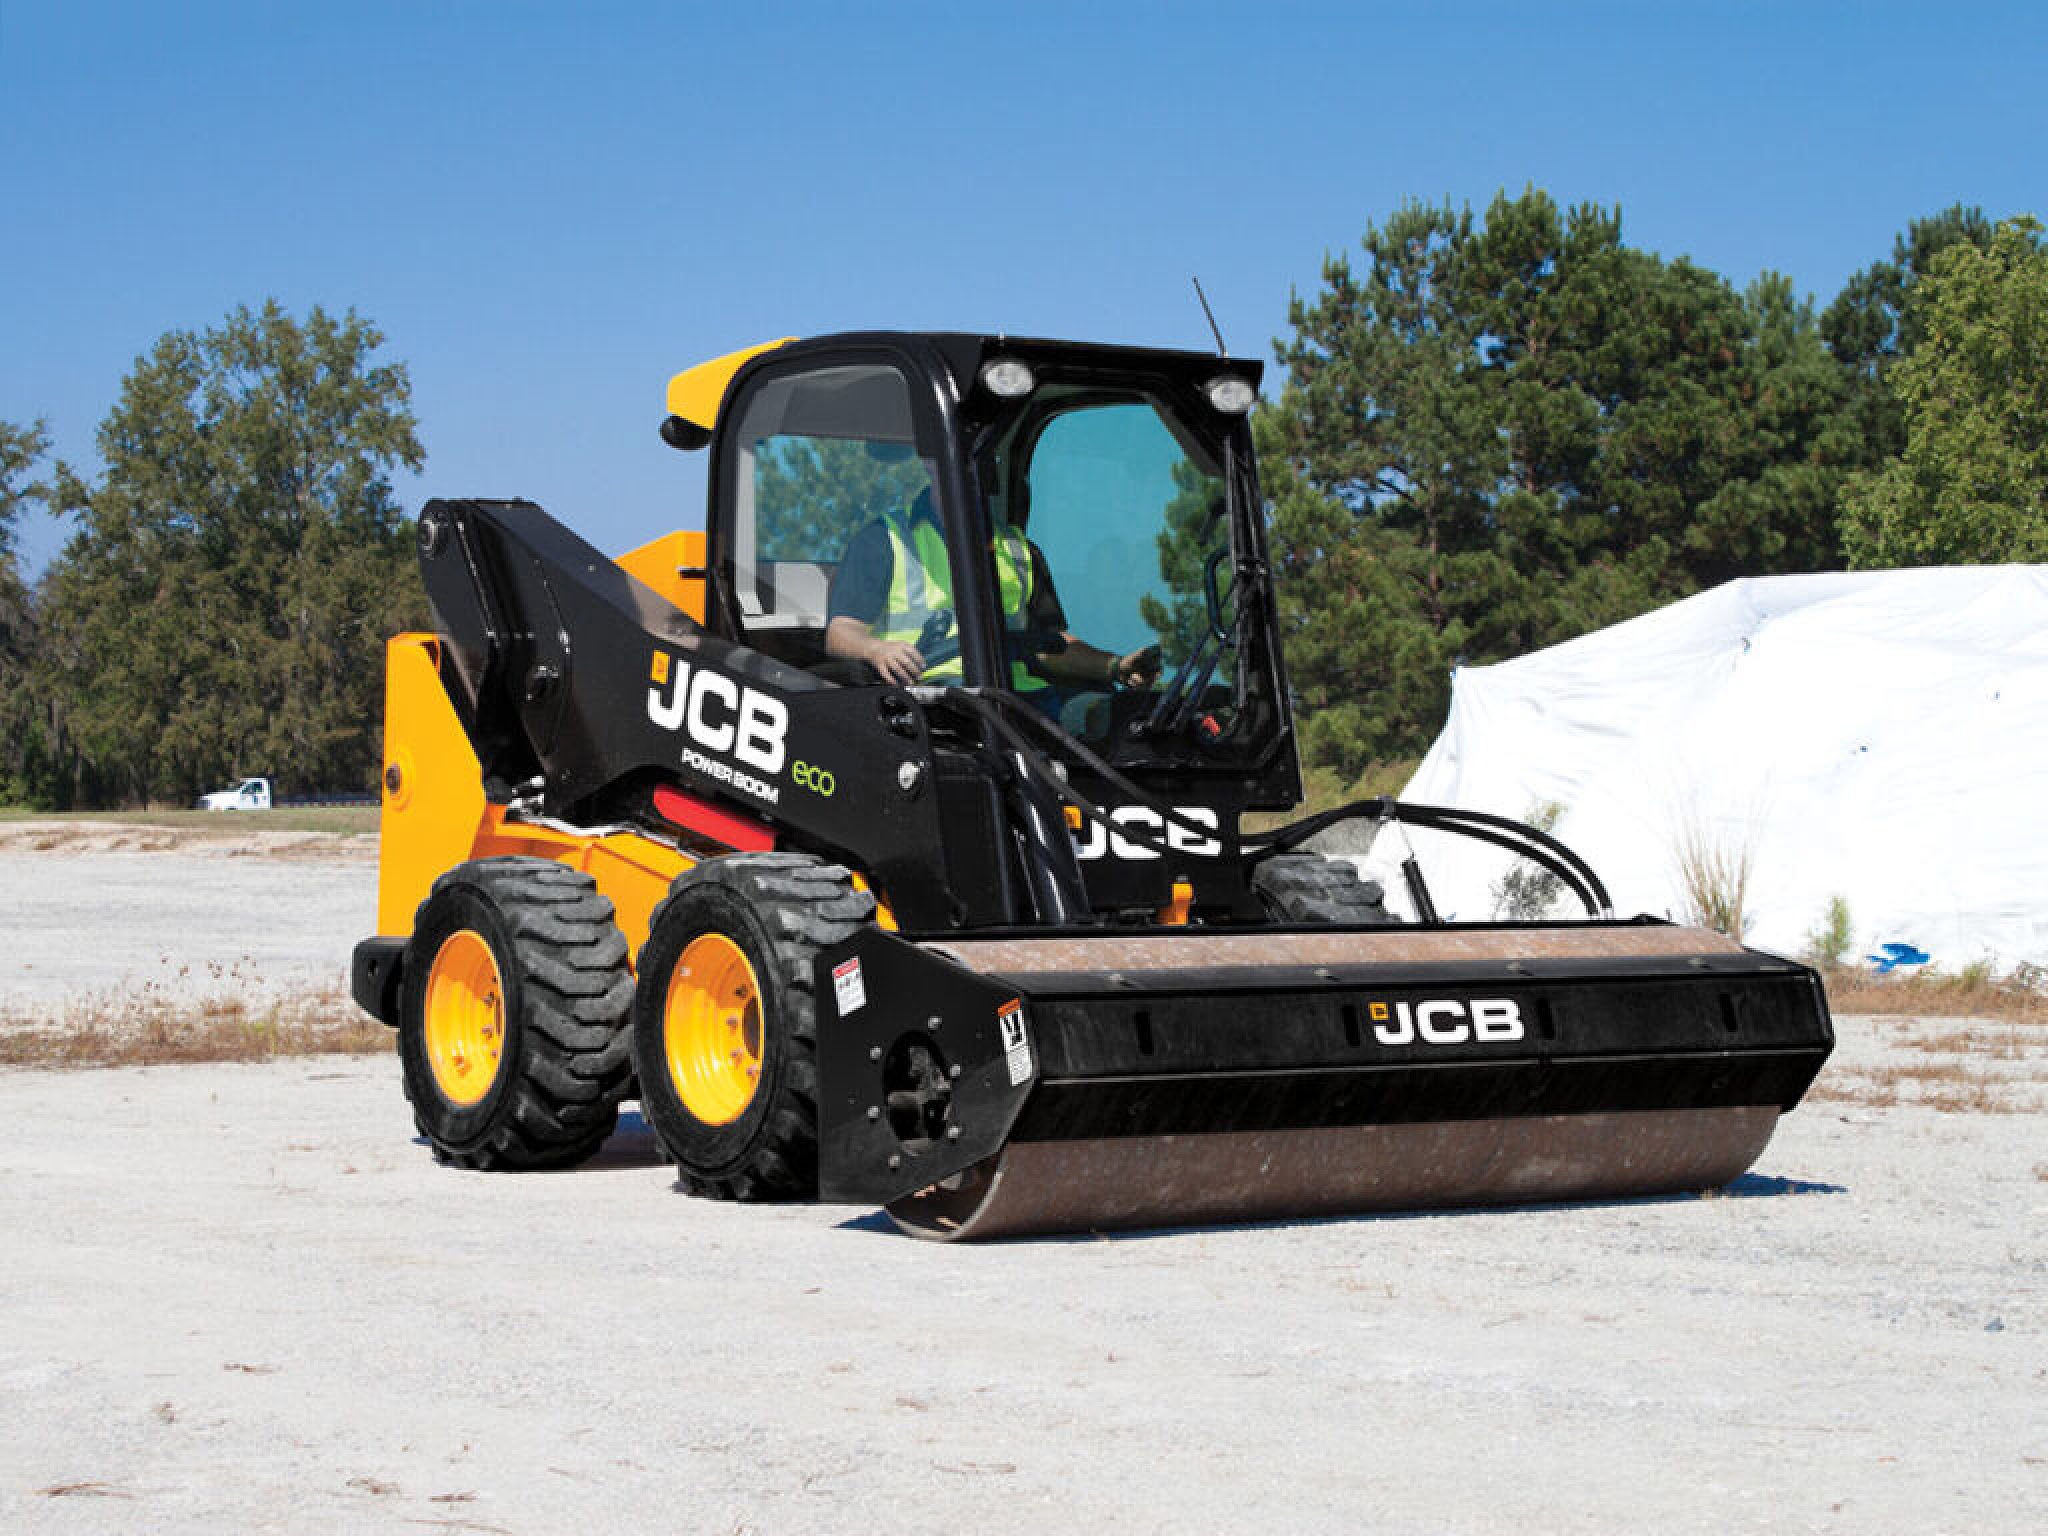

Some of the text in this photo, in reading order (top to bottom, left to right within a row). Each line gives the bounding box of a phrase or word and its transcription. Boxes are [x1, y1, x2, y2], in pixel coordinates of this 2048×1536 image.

[648, 659, 788, 774] JCB
[681, 747, 779, 805] POWER BOOM
[792, 760, 835, 797] eco
[1074, 806, 1222, 860] JCB
[1374, 999, 1525, 1045] JCB
